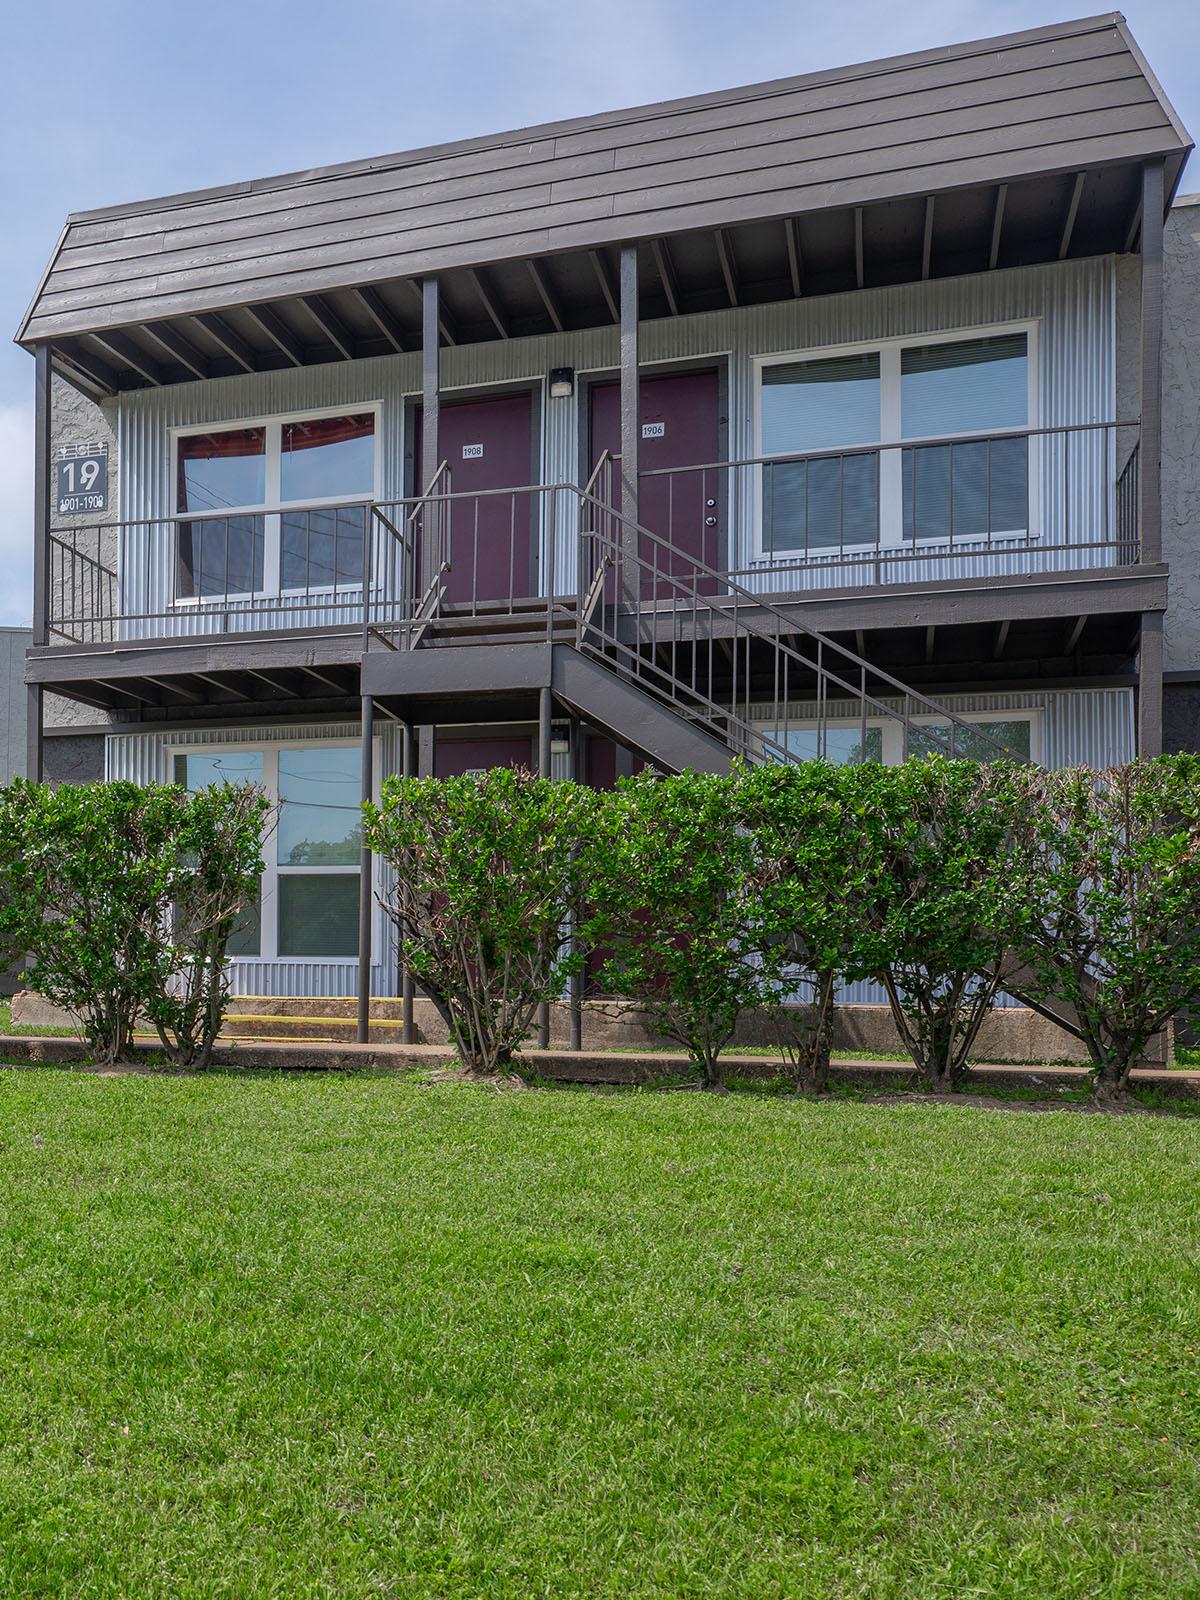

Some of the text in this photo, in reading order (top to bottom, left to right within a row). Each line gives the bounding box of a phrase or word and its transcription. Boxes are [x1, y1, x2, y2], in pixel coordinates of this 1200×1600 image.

[644, 426, 662, 435] 1906
[464, 447, 481, 456] 1908
[63, 461, 100, 492] 19
